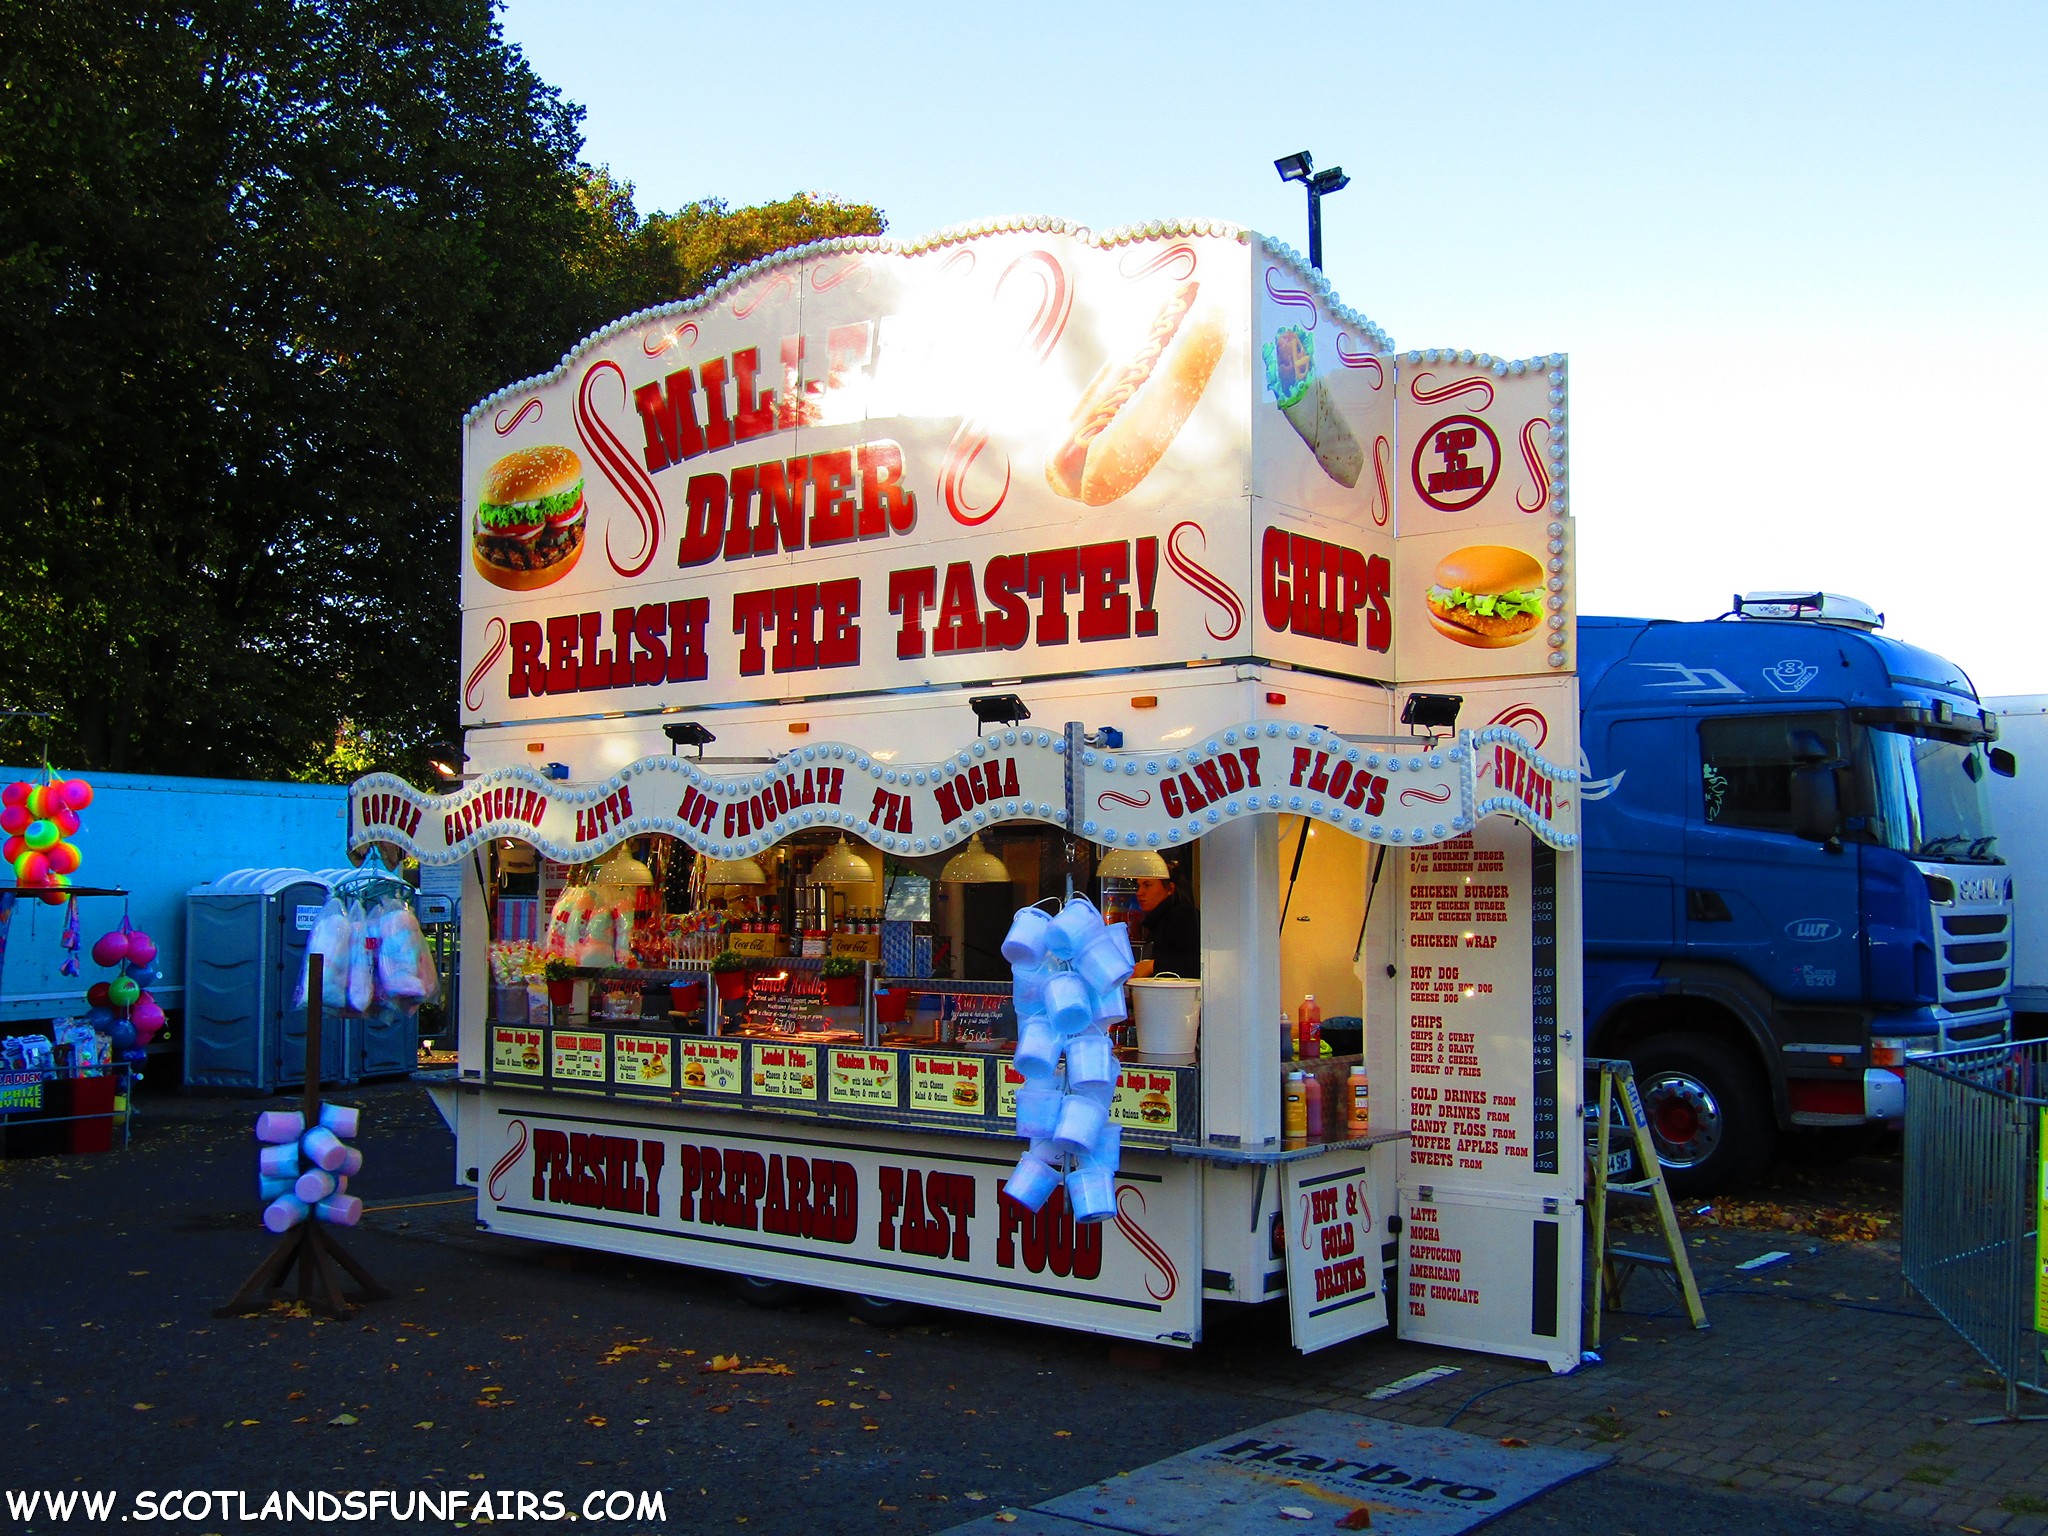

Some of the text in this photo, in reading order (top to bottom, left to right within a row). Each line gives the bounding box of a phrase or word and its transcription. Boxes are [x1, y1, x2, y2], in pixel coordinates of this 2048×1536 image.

[1428, 466, 1484, 494] NONE
[676, 438, 918, 568] DINER
[1262, 525, 1392, 654] CHIPS
[507, 535, 1161, 700] RELISH THE TASTE!
[1159, 745, 1389, 819] CANDY FLOSS
[1493, 744, 1554, 821] SWEETS
[361, 757, 1020, 846] COFFEE CAPPUCCINO LATTE HOT CHOCOLATE TEA MOCHA
[1443, 840, 1474, 850] BURGER
[1432, 851, 1469, 861] GOURMET
[1473, 851, 1504, 861] BURGER
[1432, 863, 1473, 872] ABERDEEN
[1477, 863, 1504, 872] ANGUS
[1410, 885, 1509, 898] CHICKEN BURGER
[1410, 901, 1506, 910] SPICY CHICKEN BURGER
[1410, 912, 1508, 922] PLAIN CHICKEN BURGER
[1410, 934, 1498, 948] CHICKEN WRAP
[1410, 966, 1459, 980] HOT DOG
[1806, 976, 1836, 987] 620
[1410, 982, 1430, 991] FOOT
[1434, 982, 1454, 992] LONG
[1478, 984, 1493, 993] DOG
[1410, 993, 1458, 1003] CHEESE DOG
[1410, 1015, 1442, 1029] CHIPS
[1410, 1030, 1474, 1042] CHIPS & CURRY
[1410, 1042, 1474, 1054] CHIPS & GRAVY
[1410, 1053, 1478, 1066] CHIPS & CHEESE
[4, 1072, 41, 1084] A DUCK
[1410, 1064, 1481, 1077] BUCKET OF FRIES
[4, 1085, 41, 1097] PRIZE
[1410, 1086, 1516, 1106] COLD DRINKS FROM
[1410, 1102, 1510, 1122] HOT DRINKS FROM
[1410, 1118, 1516, 1140] CANDY FLOSS FROM
[1410, 1135, 1528, 1158] TOFFEE APPLES FROM
[1410, 1151, 1482, 1170] SWEETS FROM
[532, 1128, 1103, 1280] FRESHLY PREPARED FAST FOOD
[1311, 1183, 1358, 1225] HOT &
[1410, 1207, 1437, 1222] LATTE
[1320, 1221, 1355, 1261] COLD
[1410, 1226, 1440, 1242] MOCHA
[1410, 1244, 1461, 1264] CAPPUCCINO
[1314, 1256, 1366, 1302] DRINKS
[1410, 1264, 1460, 1282] AMERICANO
[1410, 1282, 1479, 1304] HOT CHOCOLATE
[1410, 1302, 1426, 1316] TEA
[1215, 1439, 1497, 1501] Harbro
[1372, 1487, 1473, 1510] NUTRITION
